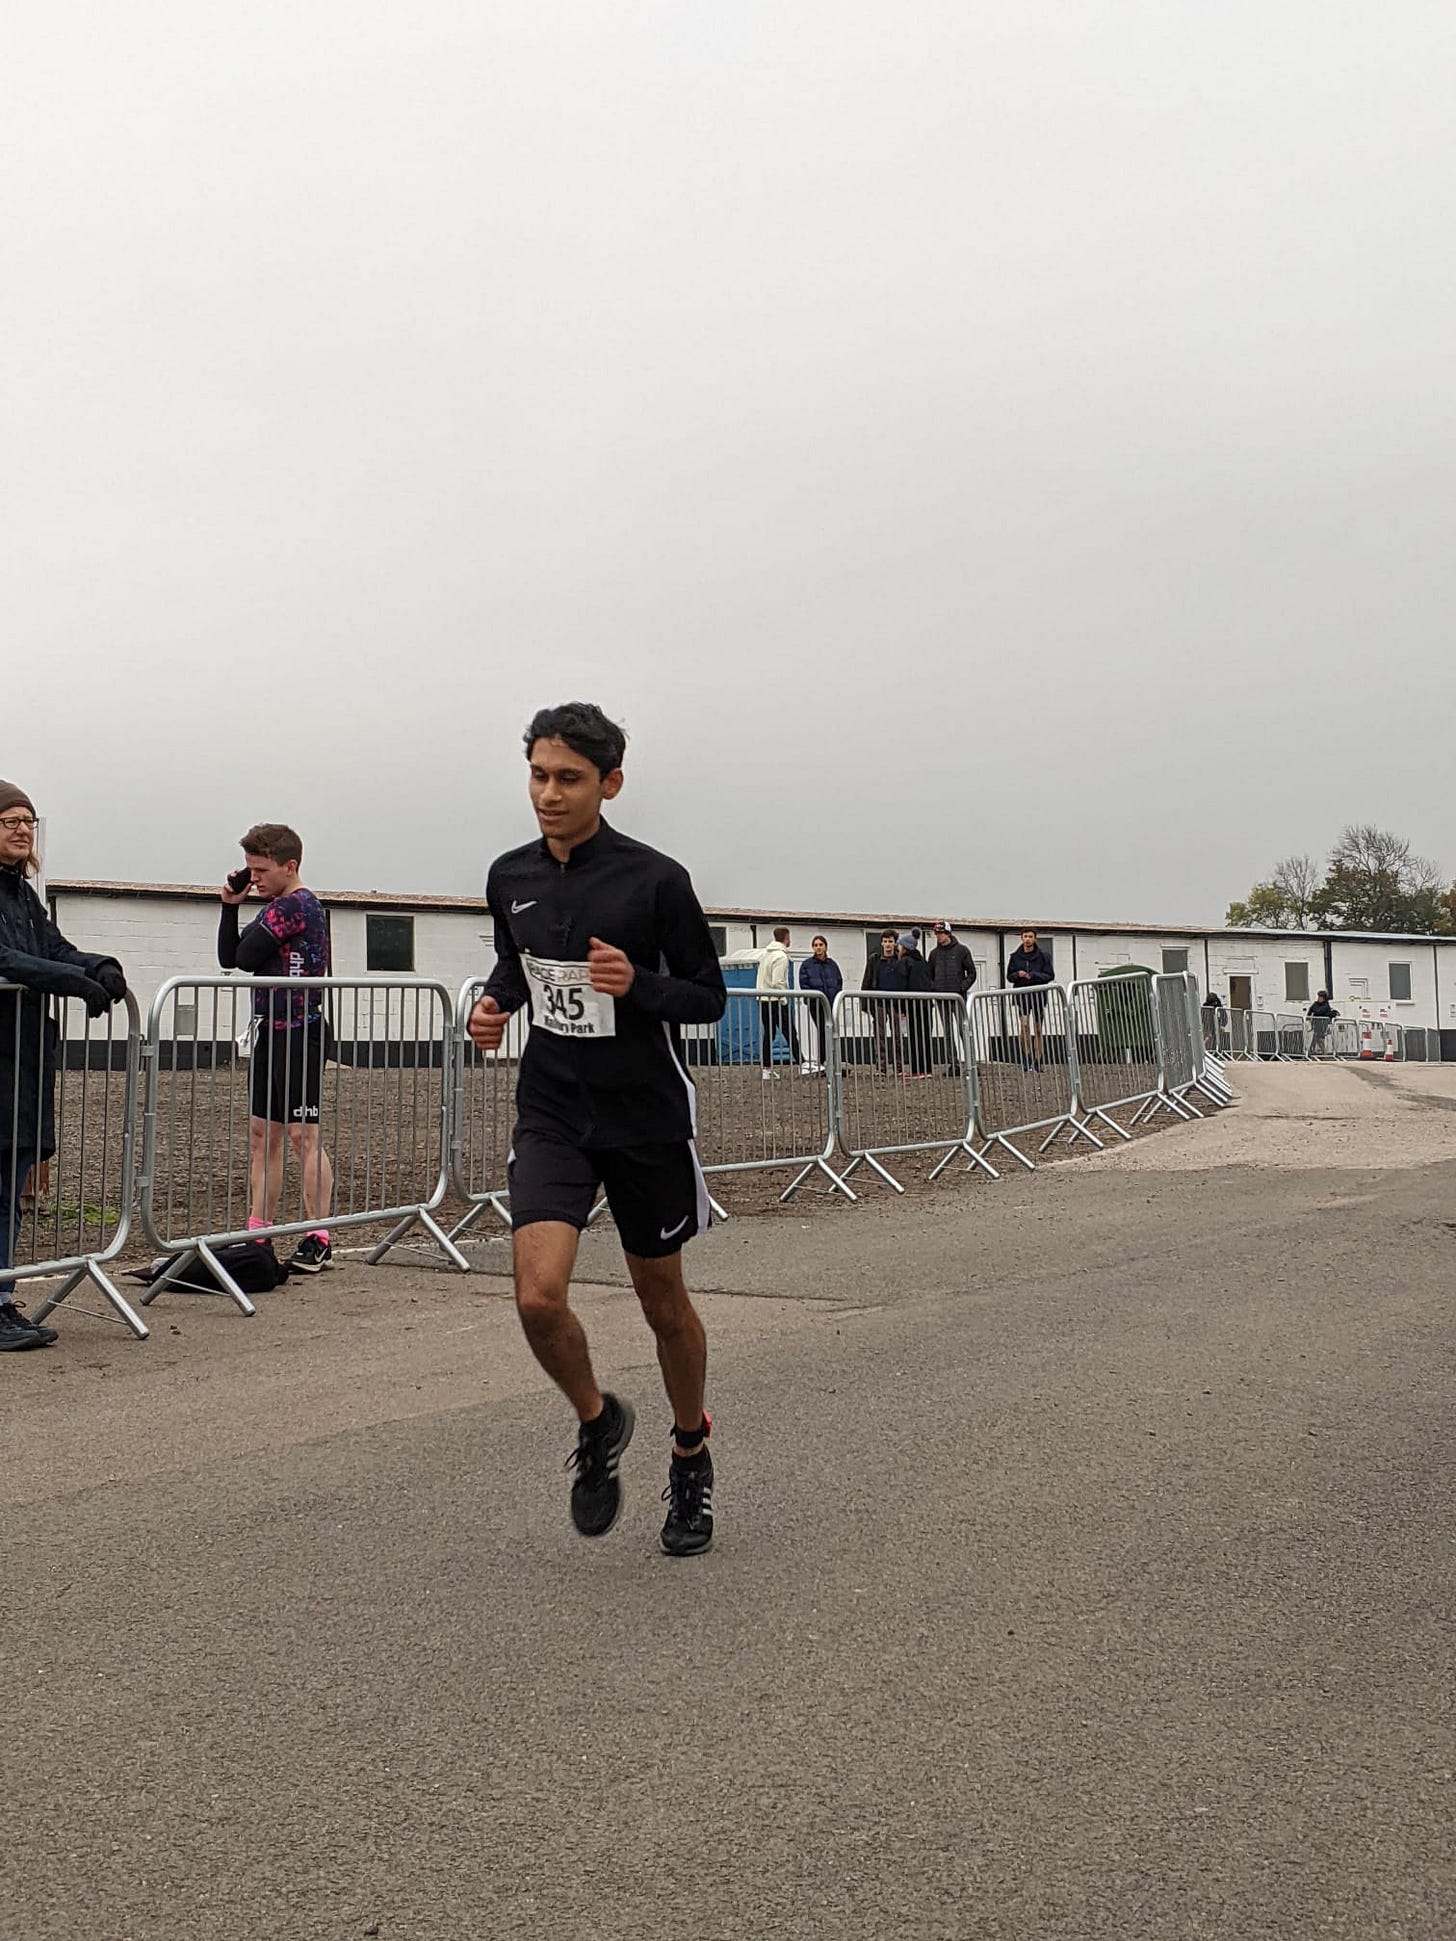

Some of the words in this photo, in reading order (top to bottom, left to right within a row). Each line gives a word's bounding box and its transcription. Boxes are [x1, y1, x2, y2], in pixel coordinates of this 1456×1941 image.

[290, 952, 304, 977] dhb
[543, 985, 584, 1020] 345
[571, 1022, 595, 1034] Park
[293, 1105, 318, 1117] dhb
